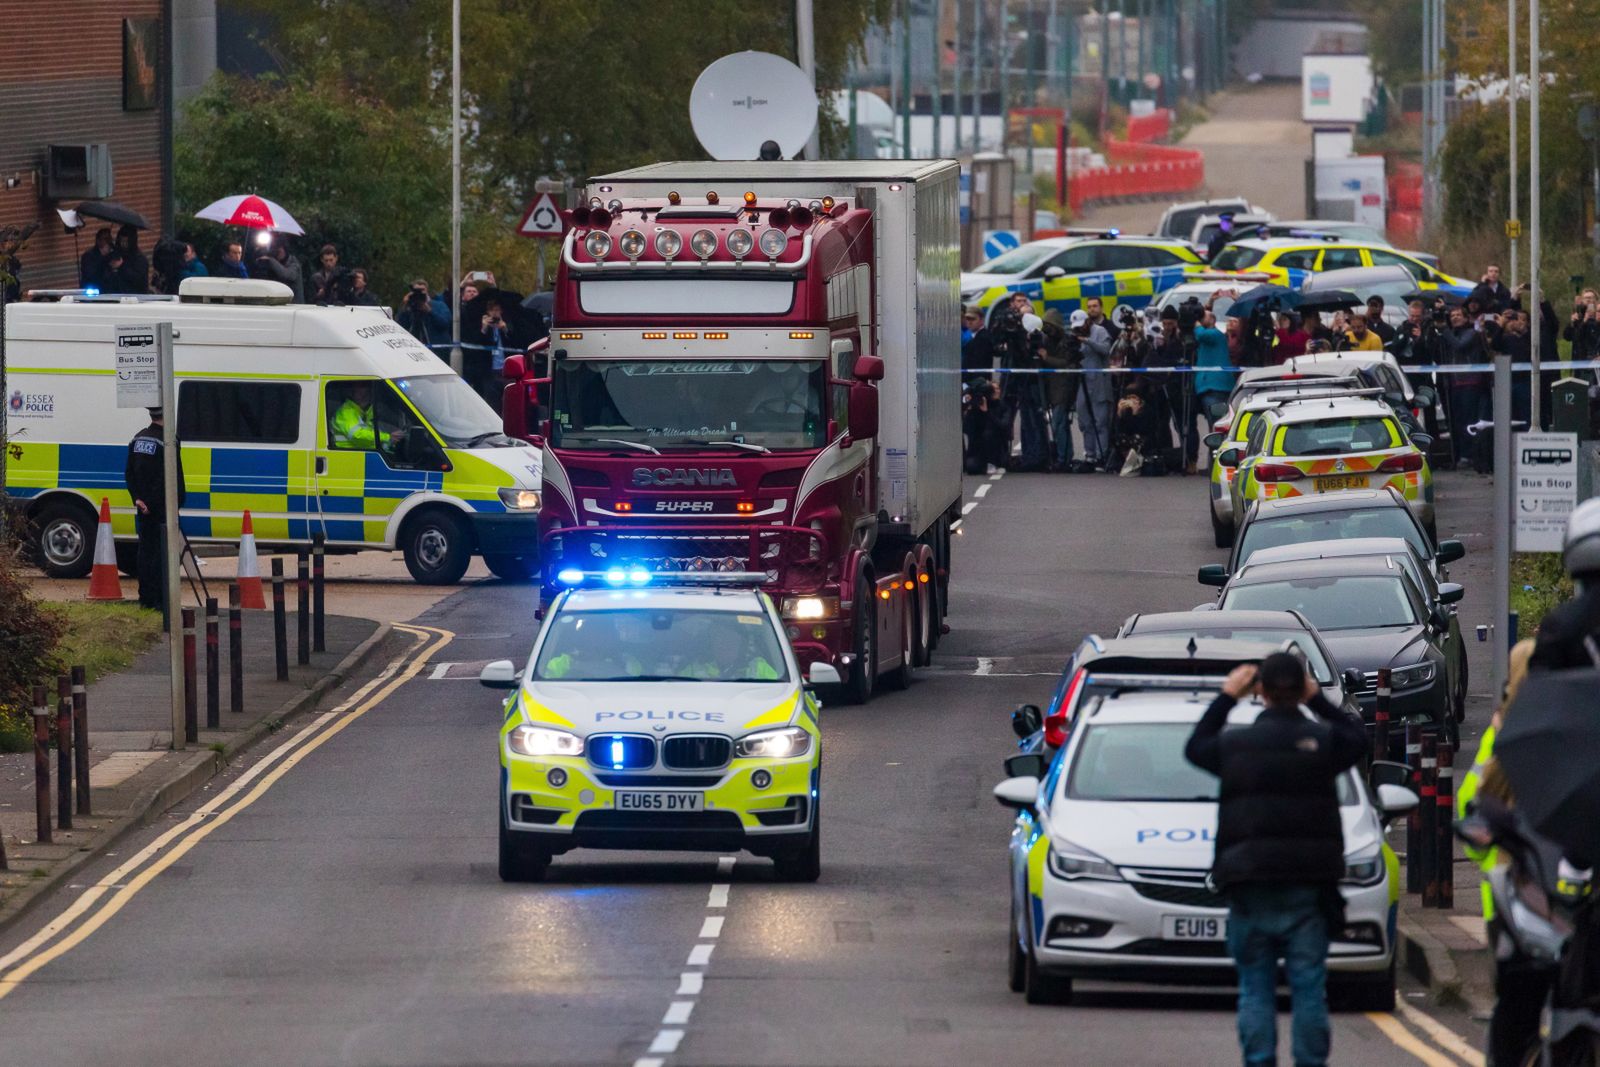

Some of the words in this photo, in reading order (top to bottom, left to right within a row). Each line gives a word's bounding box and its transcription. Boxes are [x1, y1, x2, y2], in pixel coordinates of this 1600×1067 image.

[26, 395, 54, 403] ESSEX
[1565, 392, 1575, 405] 12
[646, 428, 660, 437] The
[663, 427, 699, 436] Ultimate
[135, 441, 156, 453] POLICE
[632, 468, 737, 486] SCANIA
[1521, 479, 1542, 488] Bus
[1547, 479, 1572, 489] Stop
[656, 501, 714, 511] SUPER
[595, 710, 725, 722] POLICE
[621, 794, 662, 809] EU65
[667, 794, 697, 809] DYV
[1137, 829, 1215, 842] POL
[1174, 917, 1218, 937] EU19
